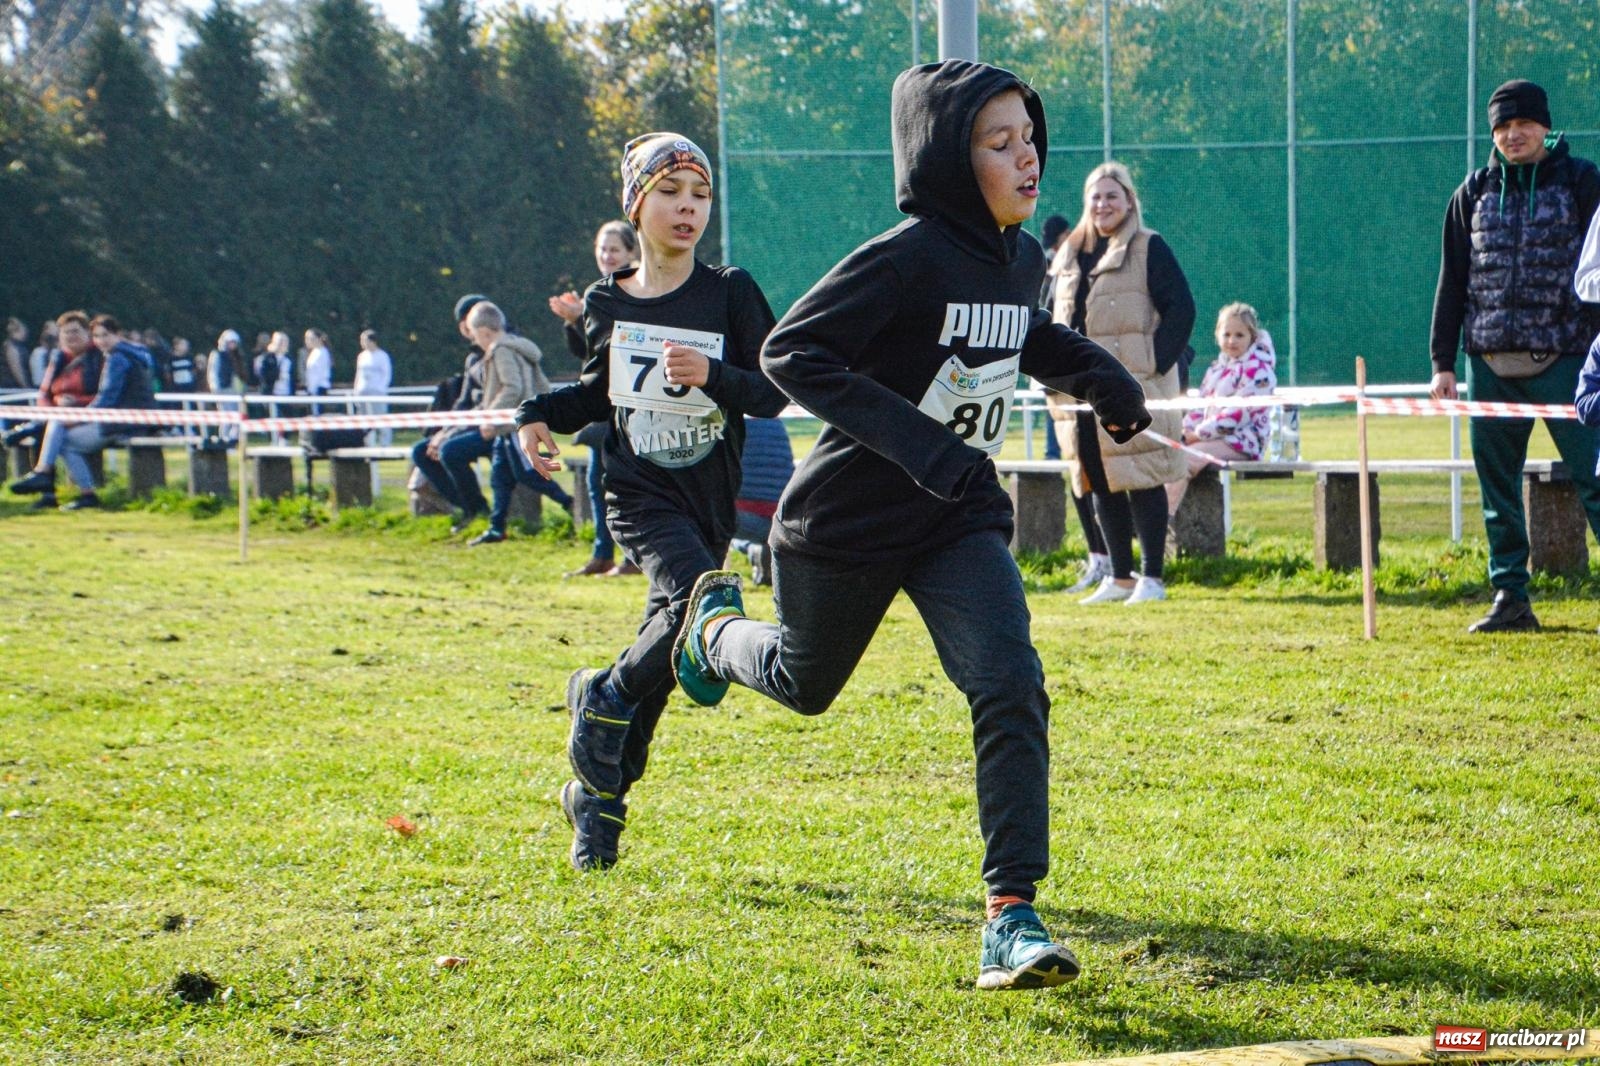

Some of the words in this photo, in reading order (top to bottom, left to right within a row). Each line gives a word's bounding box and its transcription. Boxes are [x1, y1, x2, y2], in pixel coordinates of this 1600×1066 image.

[649, 335, 716, 351] wwwersonalbest.pl
[946, 397, 1005, 442] 80
[630, 422, 725, 456] WINTER
[669, 449, 695, 460] 2020
